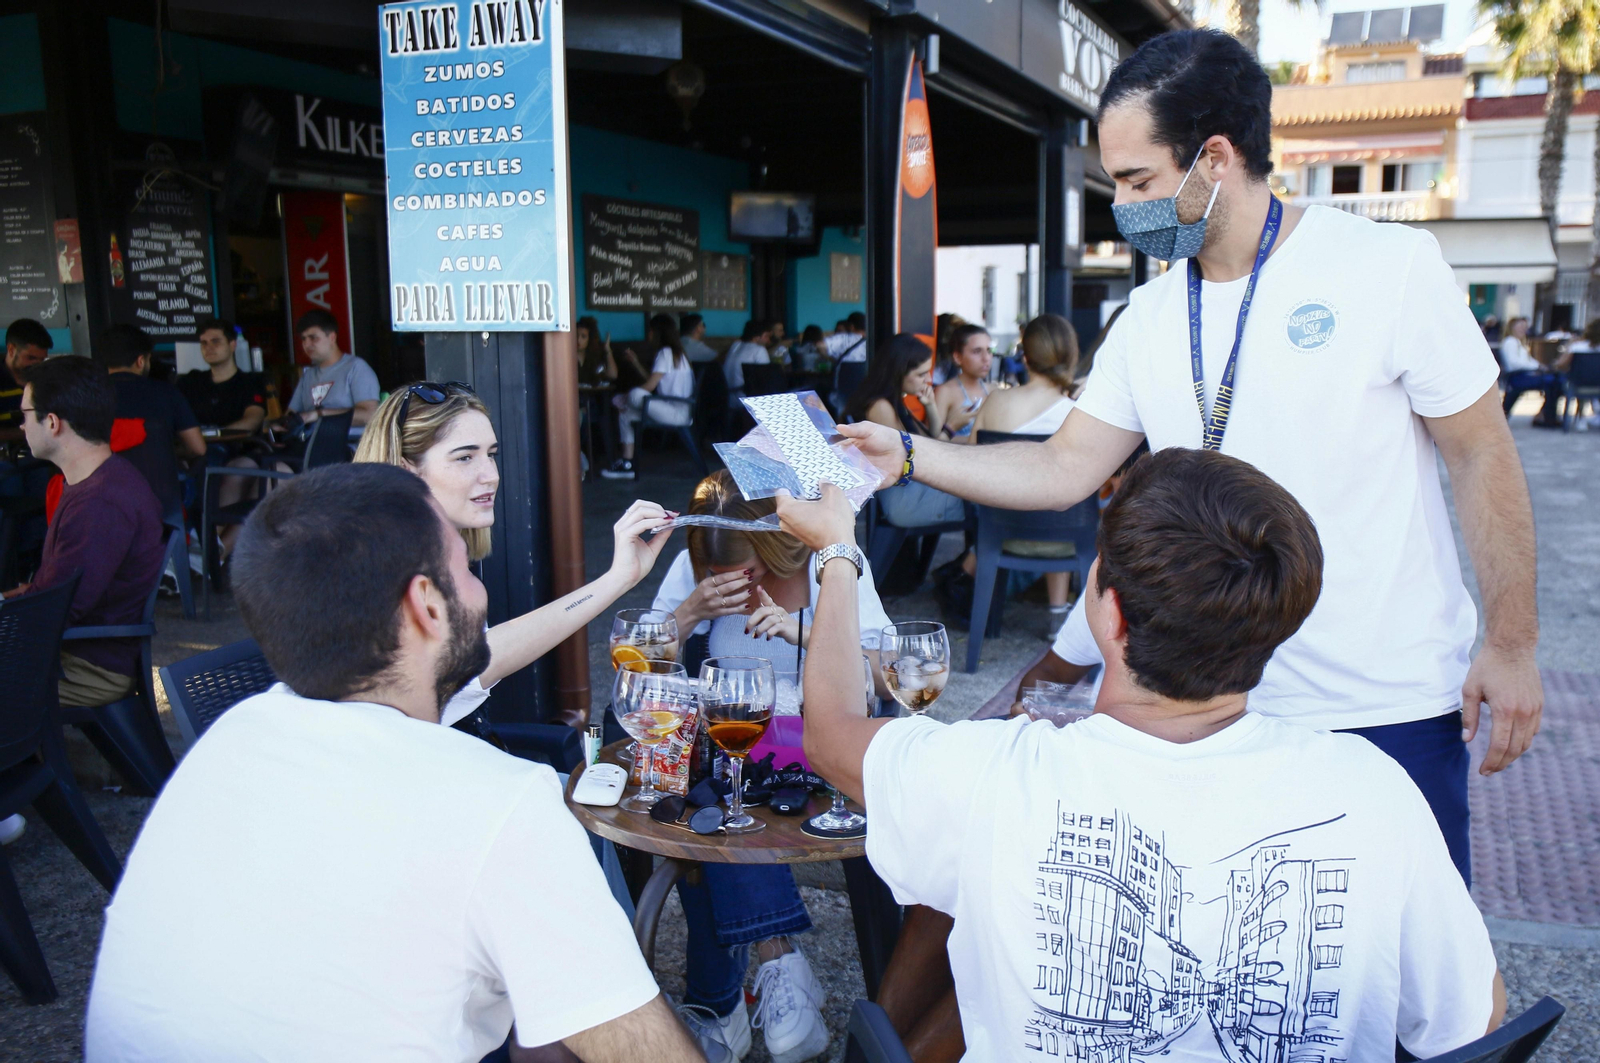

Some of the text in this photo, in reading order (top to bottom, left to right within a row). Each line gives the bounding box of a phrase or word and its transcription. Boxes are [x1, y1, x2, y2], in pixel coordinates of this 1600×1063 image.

[386, 0, 544, 53] TAKE AWAY
[424, 61, 505, 82] ZUMOS
[416, 92, 516, 115] BATIDOS
[411, 125, 523, 147] CERVEZAS
[414, 158, 522, 179] COCTELES
[393, 189, 546, 211] COMBINADOS
[436, 223, 504, 240] CAFES
[130, 238, 166, 252] INGLATERRA
[175, 249, 204, 258] ARGENTINA
[132, 256, 165, 272] ALEMANIA
[181, 260, 204, 276] ESPAÑA
[439, 256, 503, 272] AGUA
[158, 282, 177, 292] ITALIA
[190, 274, 207, 284] CUBA
[133, 291, 157, 299] POLONIA
[396, 283, 554, 322] PARA LLEVAR
[158, 298, 190, 311] IRLANDA
[137, 308, 167, 325] AUSTRALIA
[1207, 384, 1234, 451] RUMPERS
